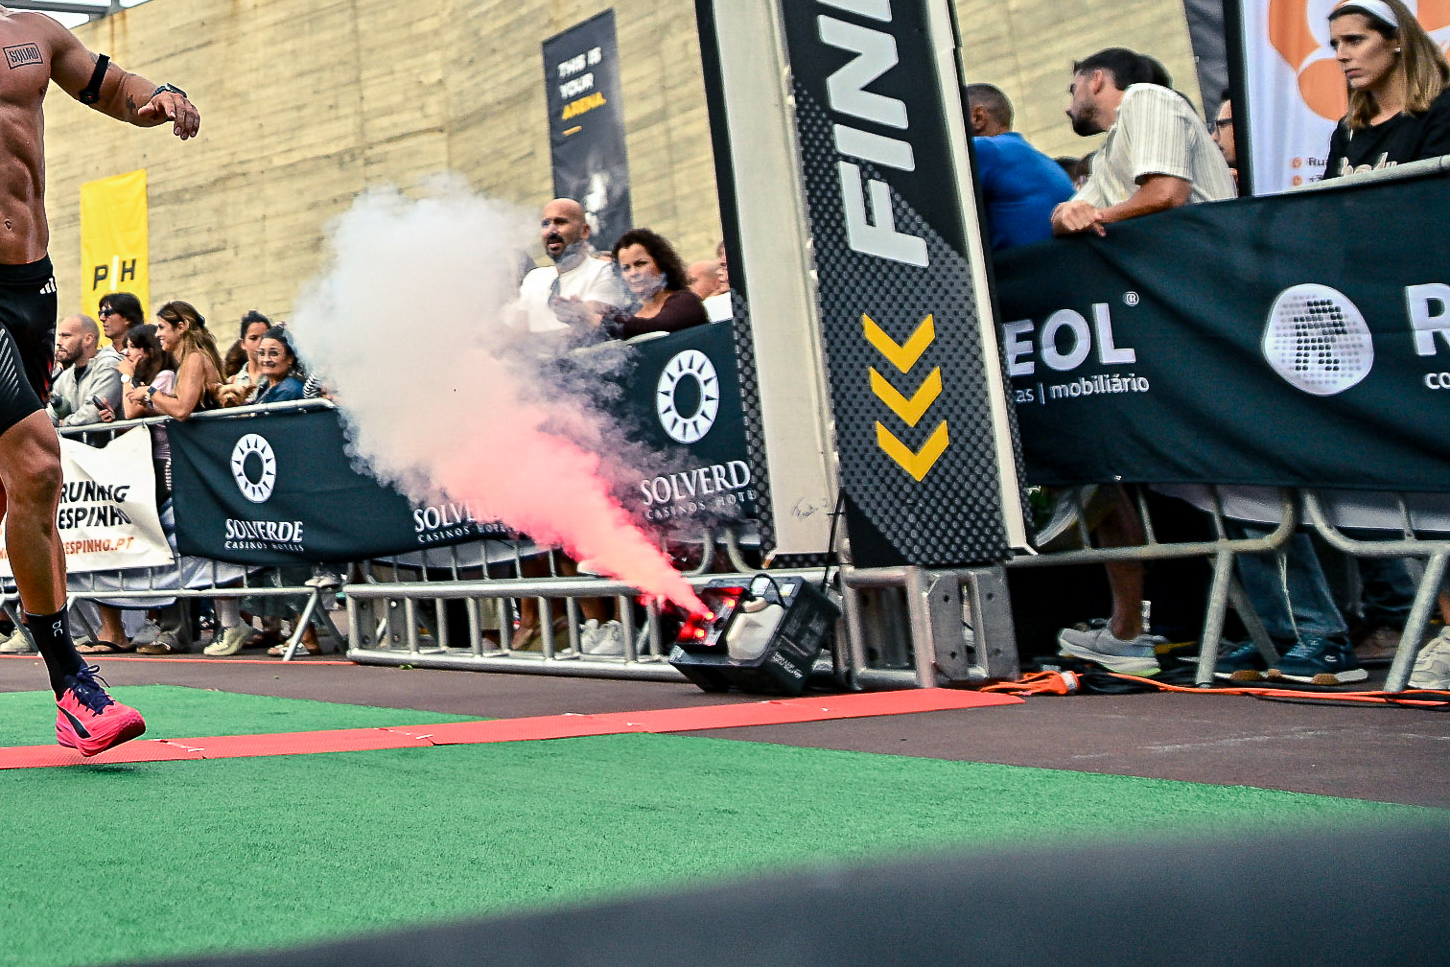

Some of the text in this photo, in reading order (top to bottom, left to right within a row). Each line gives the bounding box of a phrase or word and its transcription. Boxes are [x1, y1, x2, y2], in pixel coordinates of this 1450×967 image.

[9, 47, 39, 63] SQUAD
[557, 46, 602, 79] THIS IS
[559, 72, 594, 100] YOUR
[1050, 372, 1150, 399] mobiliário
[640, 460, 751, 507] SOLVERD
[224, 518, 304, 543] SOLVERDE
[417, 524, 471, 544] CASINOS
